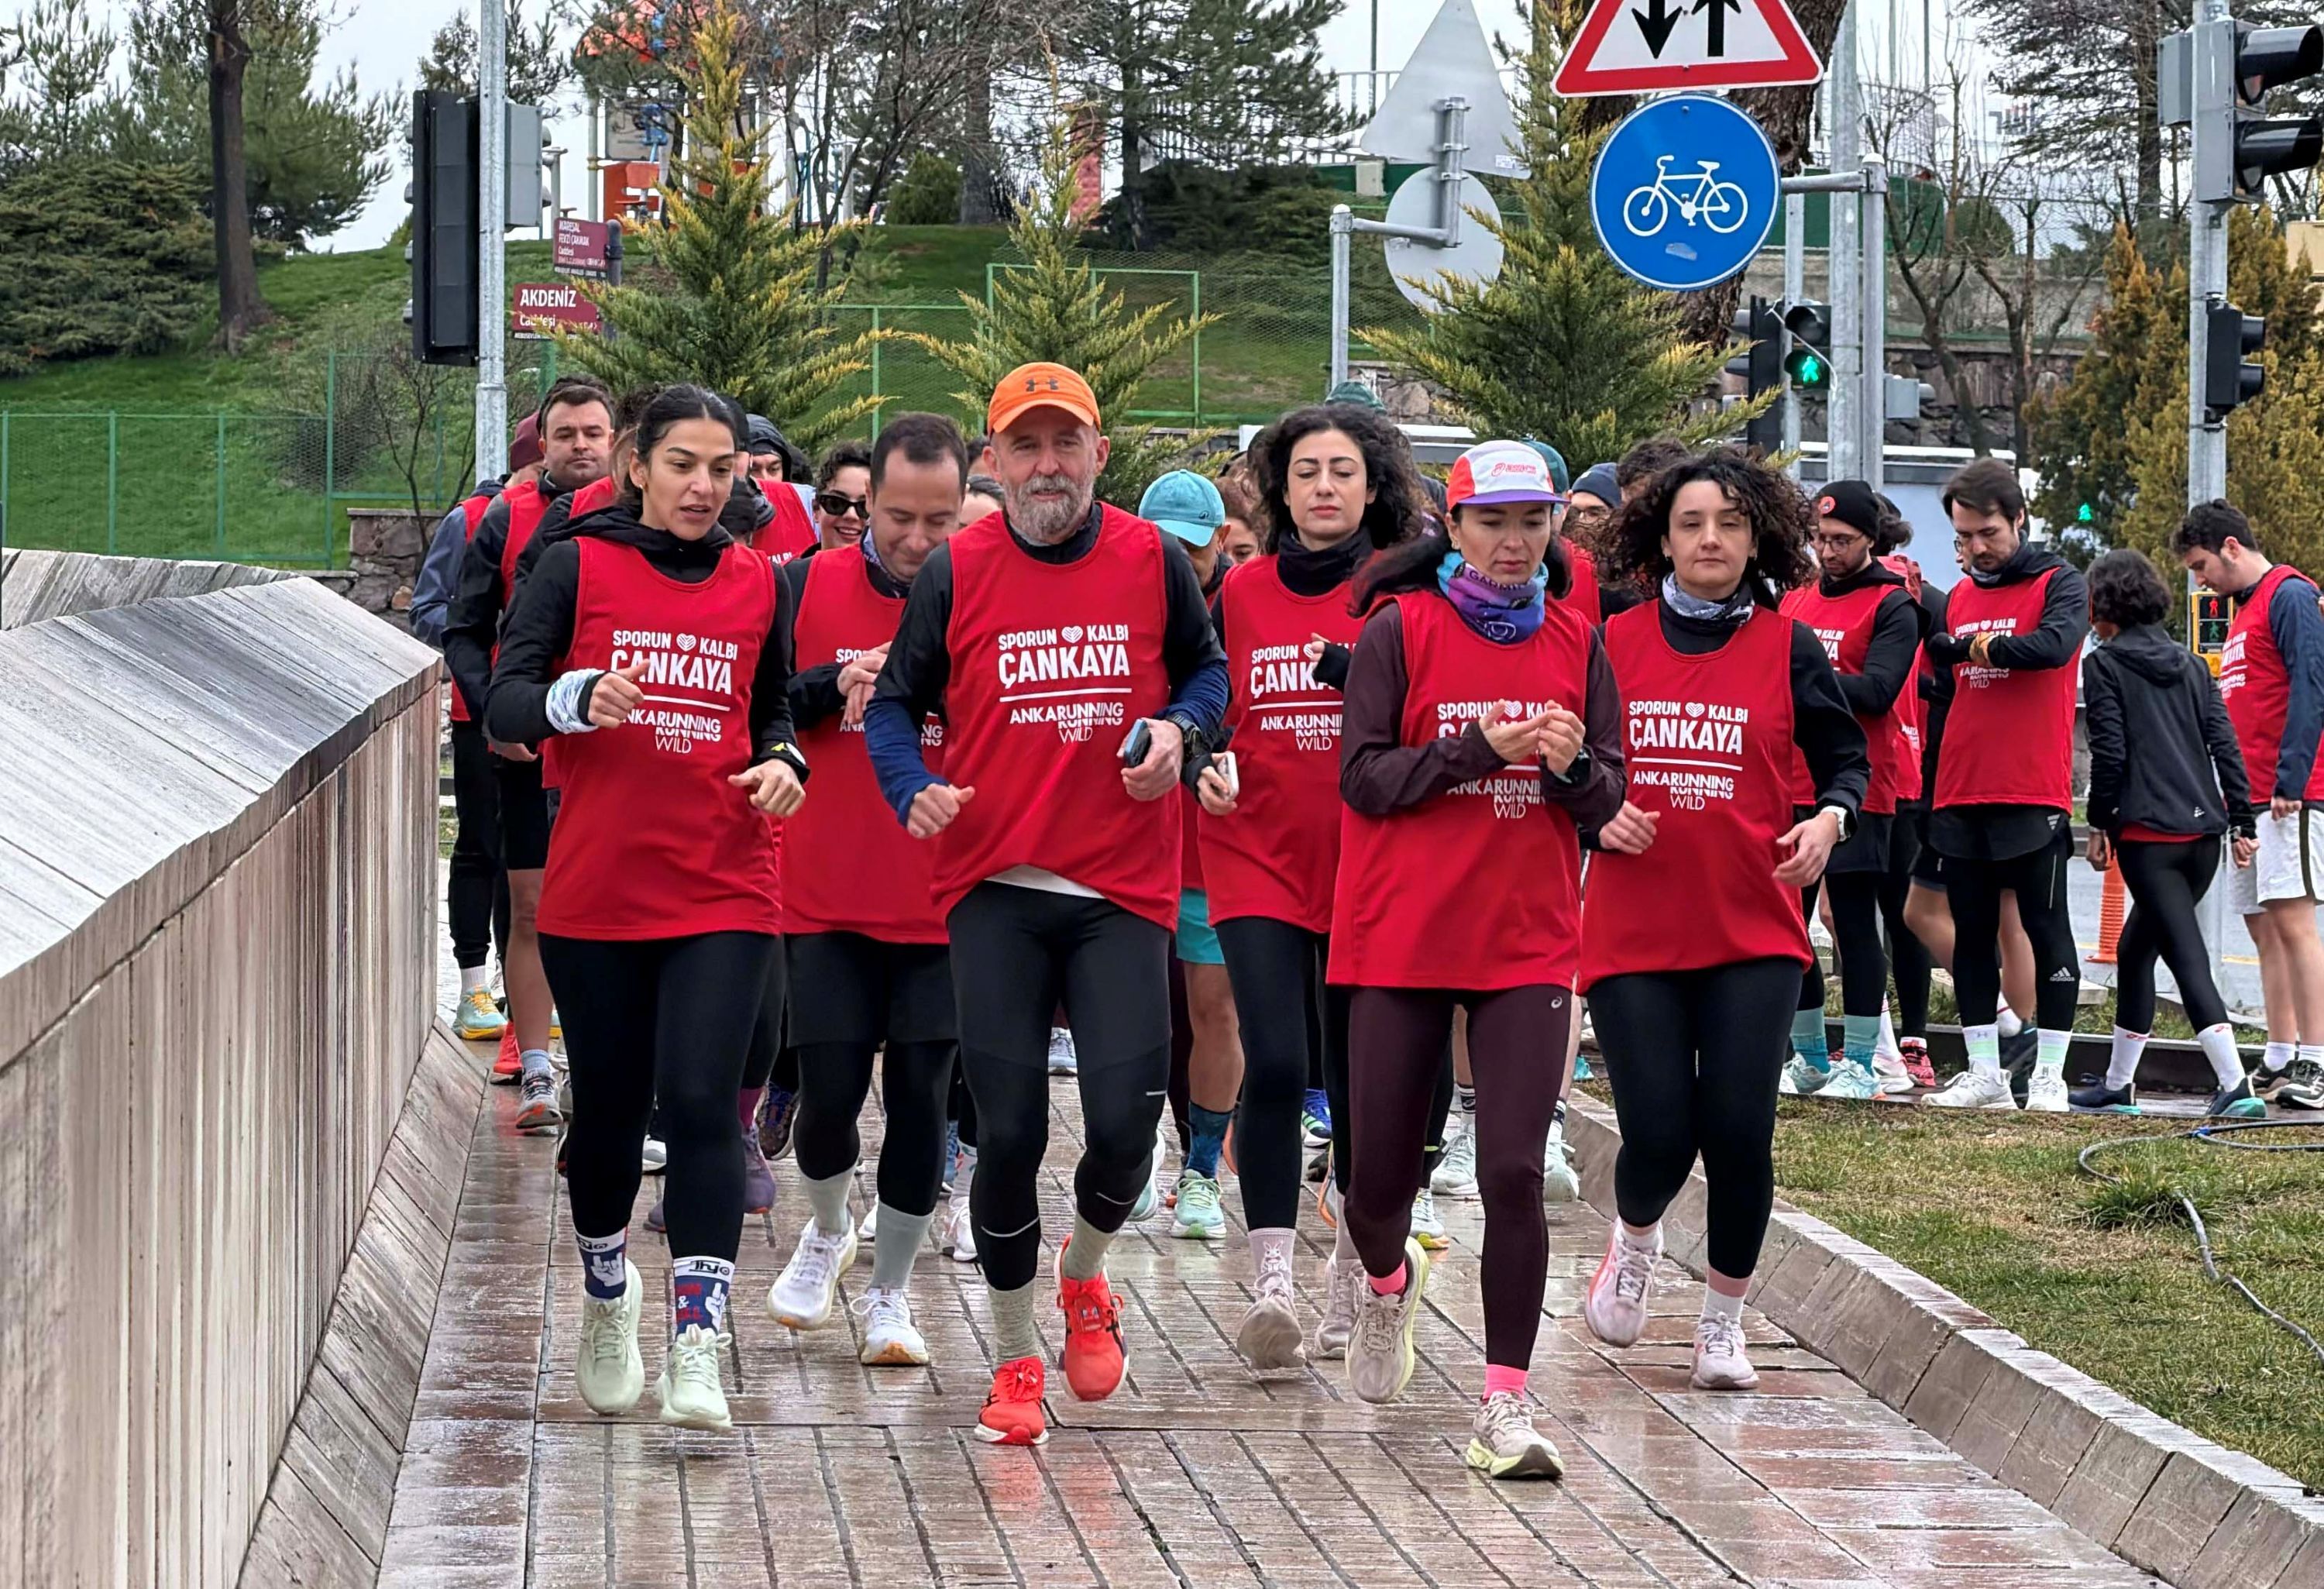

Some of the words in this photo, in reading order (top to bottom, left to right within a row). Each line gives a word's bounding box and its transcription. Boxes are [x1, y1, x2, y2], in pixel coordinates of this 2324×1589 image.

[520, 286, 576, 308] AKDENİZ
[520, 313, 556, 329] Caesi
[1469, 569, 1521, 591] GAR
[613, 630, 672, 649] SPORUN
[998, 628, 1057, 651] SPORUN
[1252, 645, 1299, 665] SPORUN
[999, 644, 1130, 690] ÇANKAYA
[1250, 662, 1336, 700] ÇANK
[1009, 702, 1124, 724] ANKARUNNING
[1628, 700, 1681, 717] SPORUN
[622, 709, 721, 733] NKARUNNING
[1260, 714, 1343, 731] ANKARUNNI
[655, 735, 692, 754] WILD
[1058, 726, 1094, 745] WILD
[1295, 737, 1332, 752] WILD
[1628, 717, 1742, 755] ÇANKAYA
[1446, 778, 1541, 796] NKARUNNI
[1632, 770, 1734, 792] ANKARUNNING
[1494, 803, 1526, 819] WILD
[1670, 794, 1706, 810] WILD
[678, 1295, 689, 1309] &
